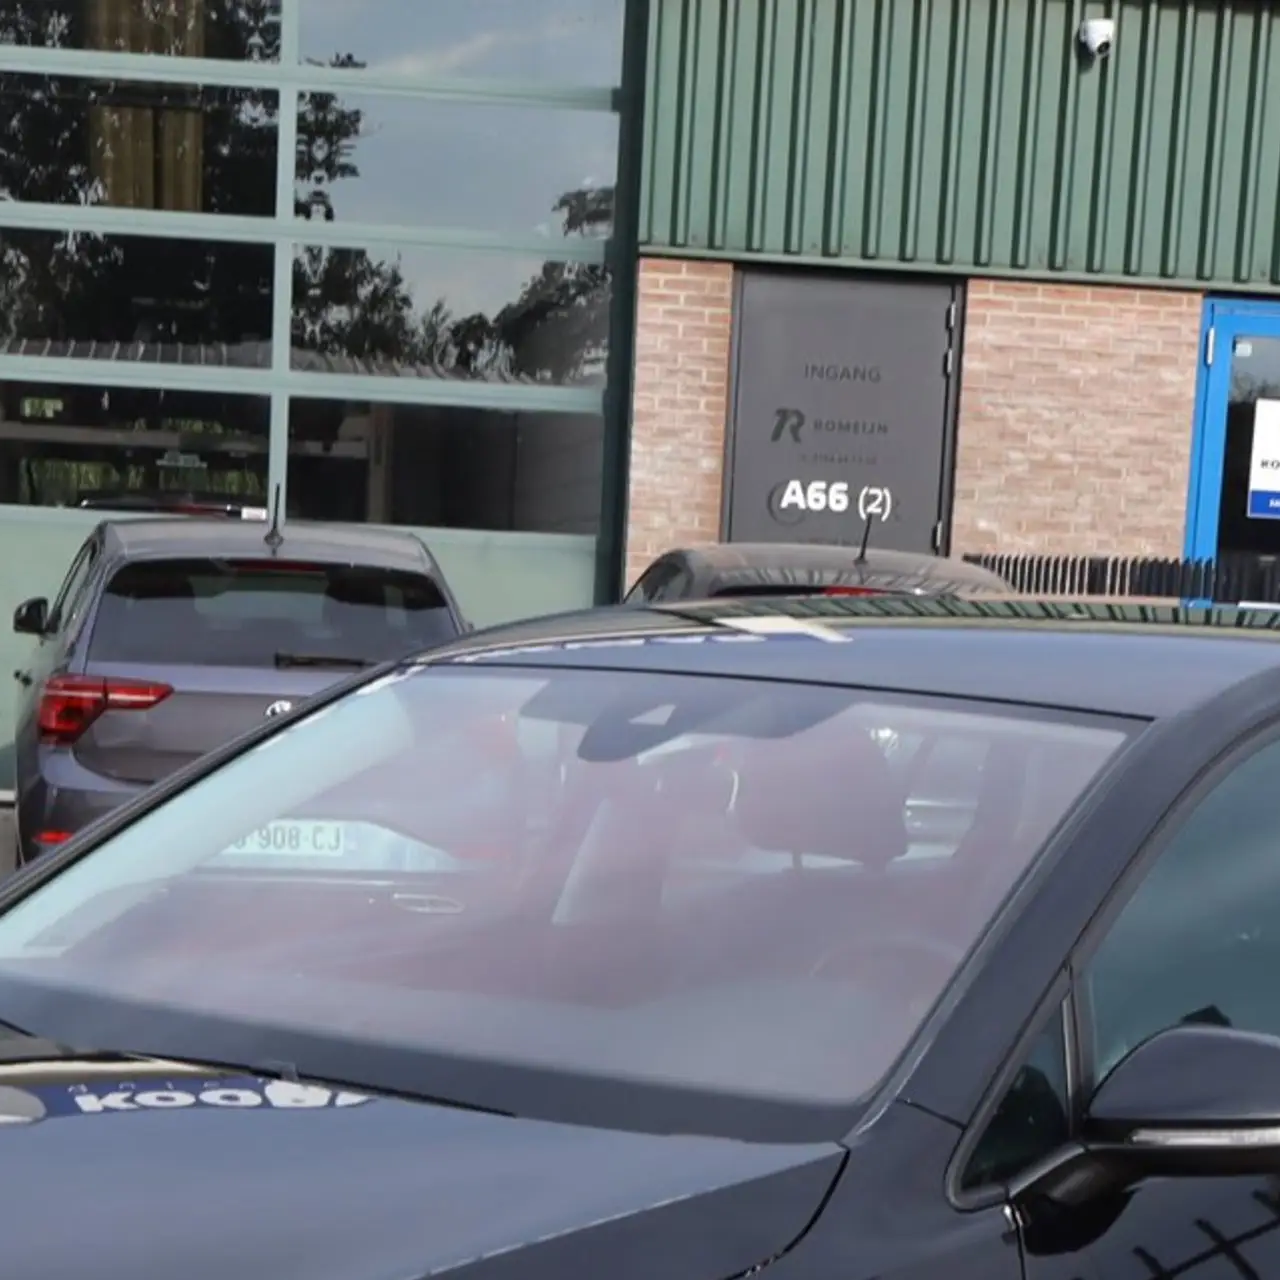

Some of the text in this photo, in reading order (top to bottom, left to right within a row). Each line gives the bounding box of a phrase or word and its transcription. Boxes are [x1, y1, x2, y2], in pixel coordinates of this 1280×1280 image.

[804, 363, 882, 383] INGANG
[780, 479, 849, 512] A66
[858, 486, 892, 522] (2)
